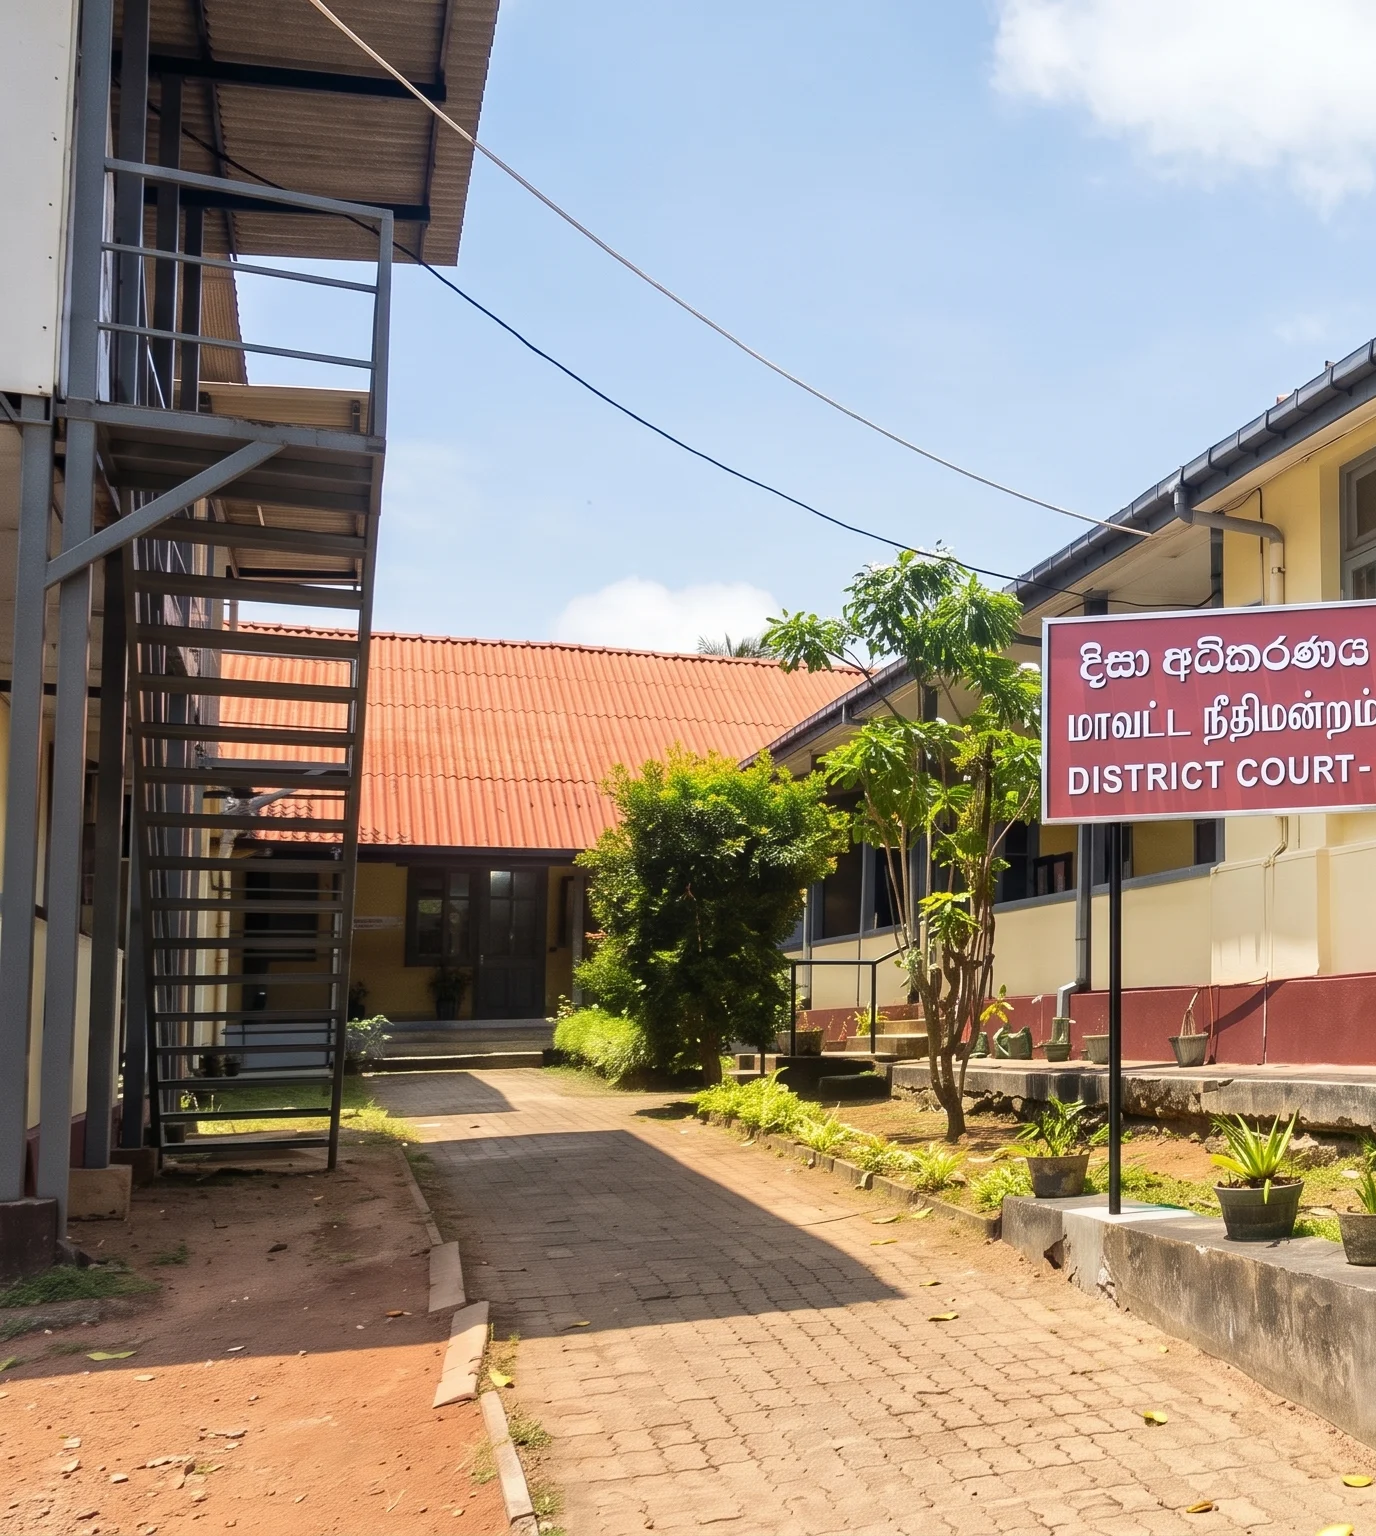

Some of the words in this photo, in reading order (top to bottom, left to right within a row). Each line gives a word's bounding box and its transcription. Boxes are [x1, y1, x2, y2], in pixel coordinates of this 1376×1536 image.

[1079, 641, 1150, 689] දිසා
[1162, 635, 1369, 682] අධිකරණය
[1068, 700, 1191, 742] மாவட்ட
[1068, 760, 1224, 795] DISTRICT
